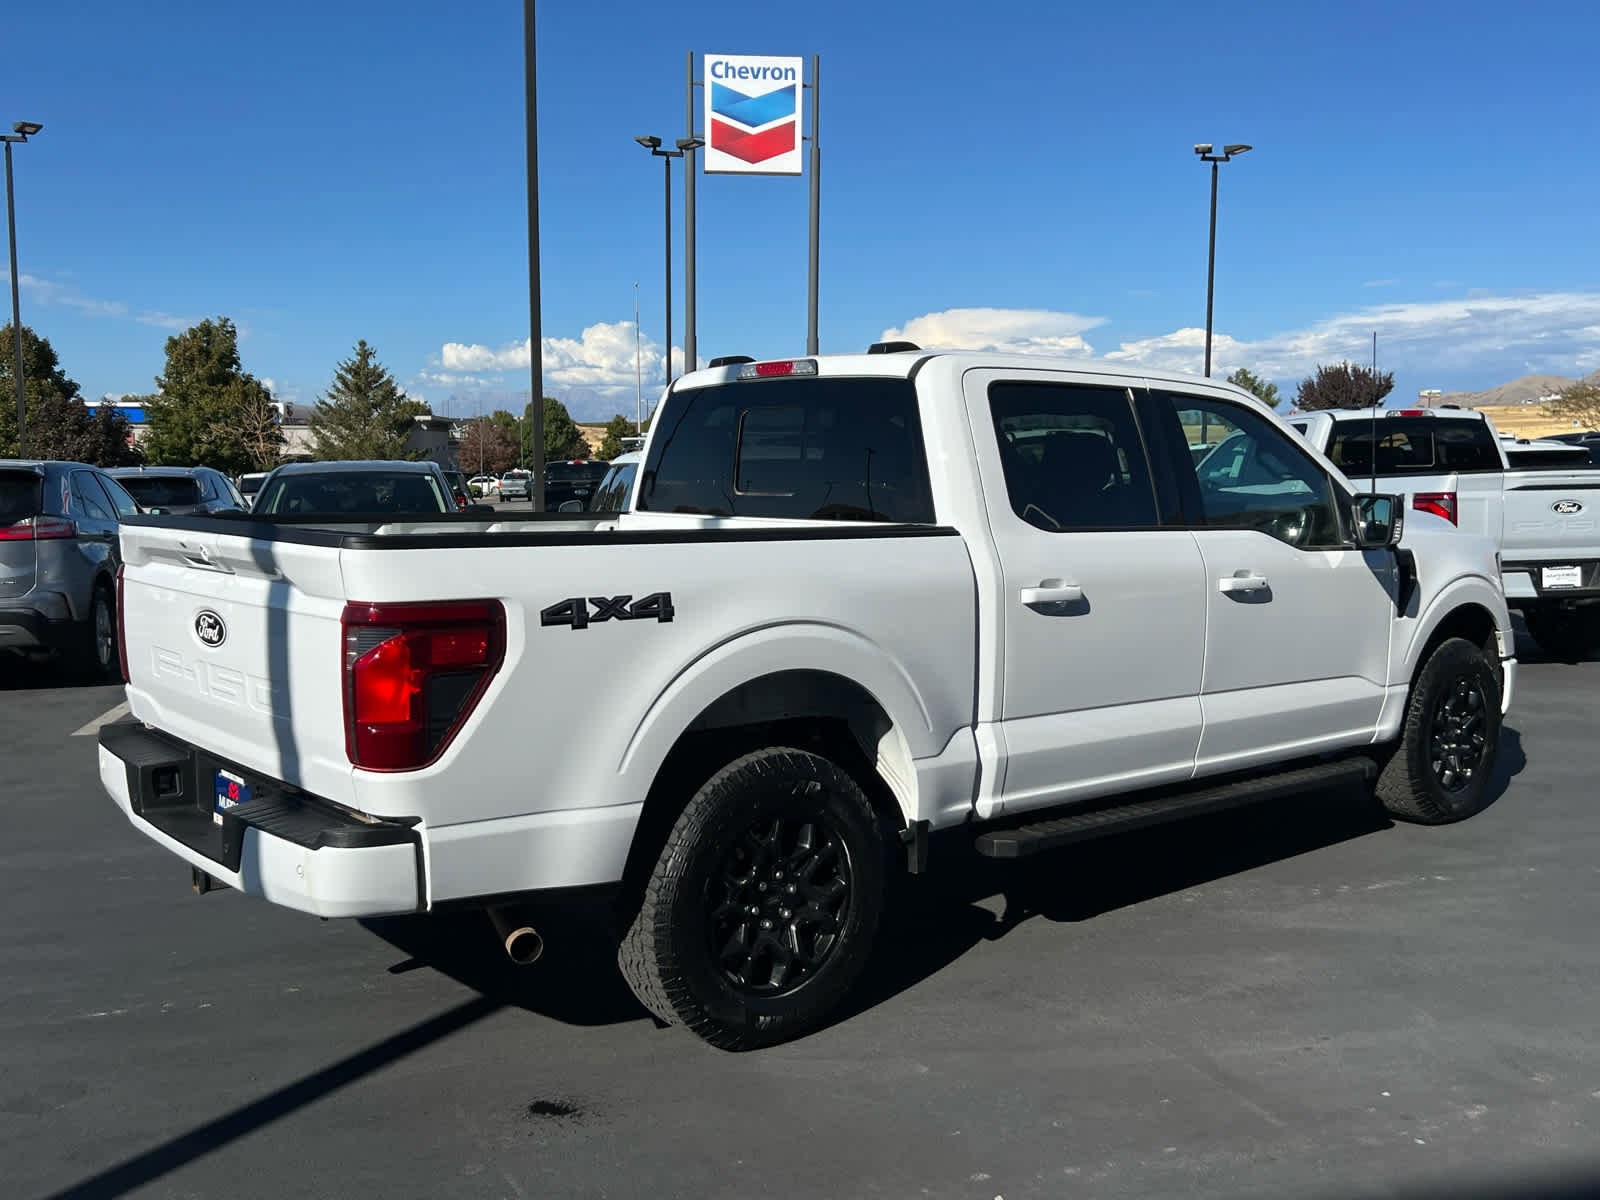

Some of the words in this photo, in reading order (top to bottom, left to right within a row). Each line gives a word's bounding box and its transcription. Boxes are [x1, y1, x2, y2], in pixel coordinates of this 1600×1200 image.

[711, 61, 796, 80] Chevron
[1557, 502, 1579, 512] Ford
[198, 615, 220, 642] Ford
